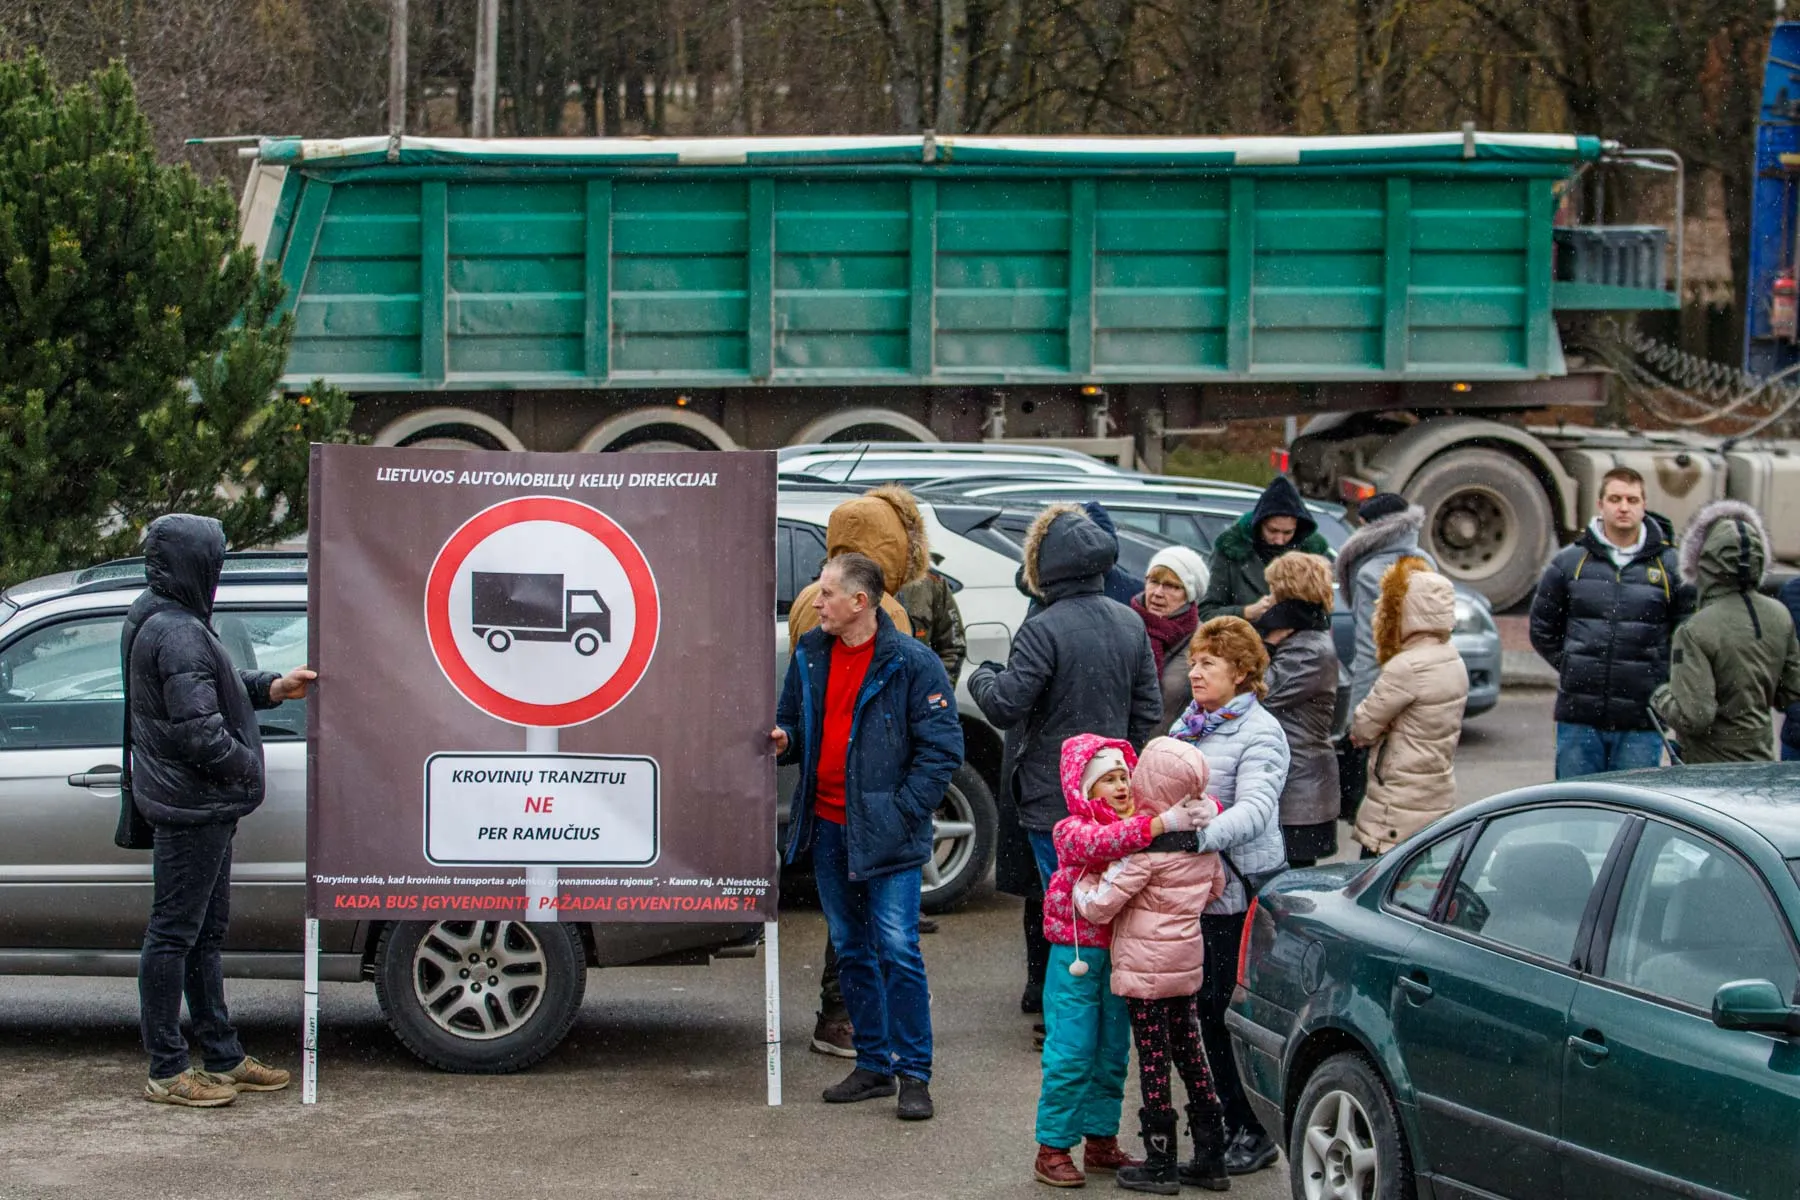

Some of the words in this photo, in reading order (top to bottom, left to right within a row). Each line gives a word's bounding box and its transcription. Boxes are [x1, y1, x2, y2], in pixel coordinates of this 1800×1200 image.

[376, 467, 455, 484] LIETUVOS
[457, 470, 574, 490] AUTOMOBILIŲ
[579, 473, 625, 490] KELIŲ
[628, 473, 718, 487] DIREKCIJAI
[451, 770, 533, 786] KROVINIŲ
[538, 771, 627, 785] TRANZITUI
[524, 796, 554, 813] NE
[478, 827, 508, 840] PER
[512, 824, 601, 840] RAMUČIUS
[388, 875, 404, 884] kad
[406, 875, 451, 885] krovininis
[453, 876, 504, 887] transportas
[548, 876, 618, 888] gyvenamuosius
[669, 877, 698, 886] Kauno
[699, 877, 714, 888] raj.
[334, 894, 381, 909] KADA
[386, 895, 418, 909] BUS
[421, 895, 531, 912] ĮGYVENDINTI
[538, 893, 612, 910] PAŽADAI
[616, 896, 739, 911] GYVENTOJAMS
[742, 897, 758, 911] ?!
